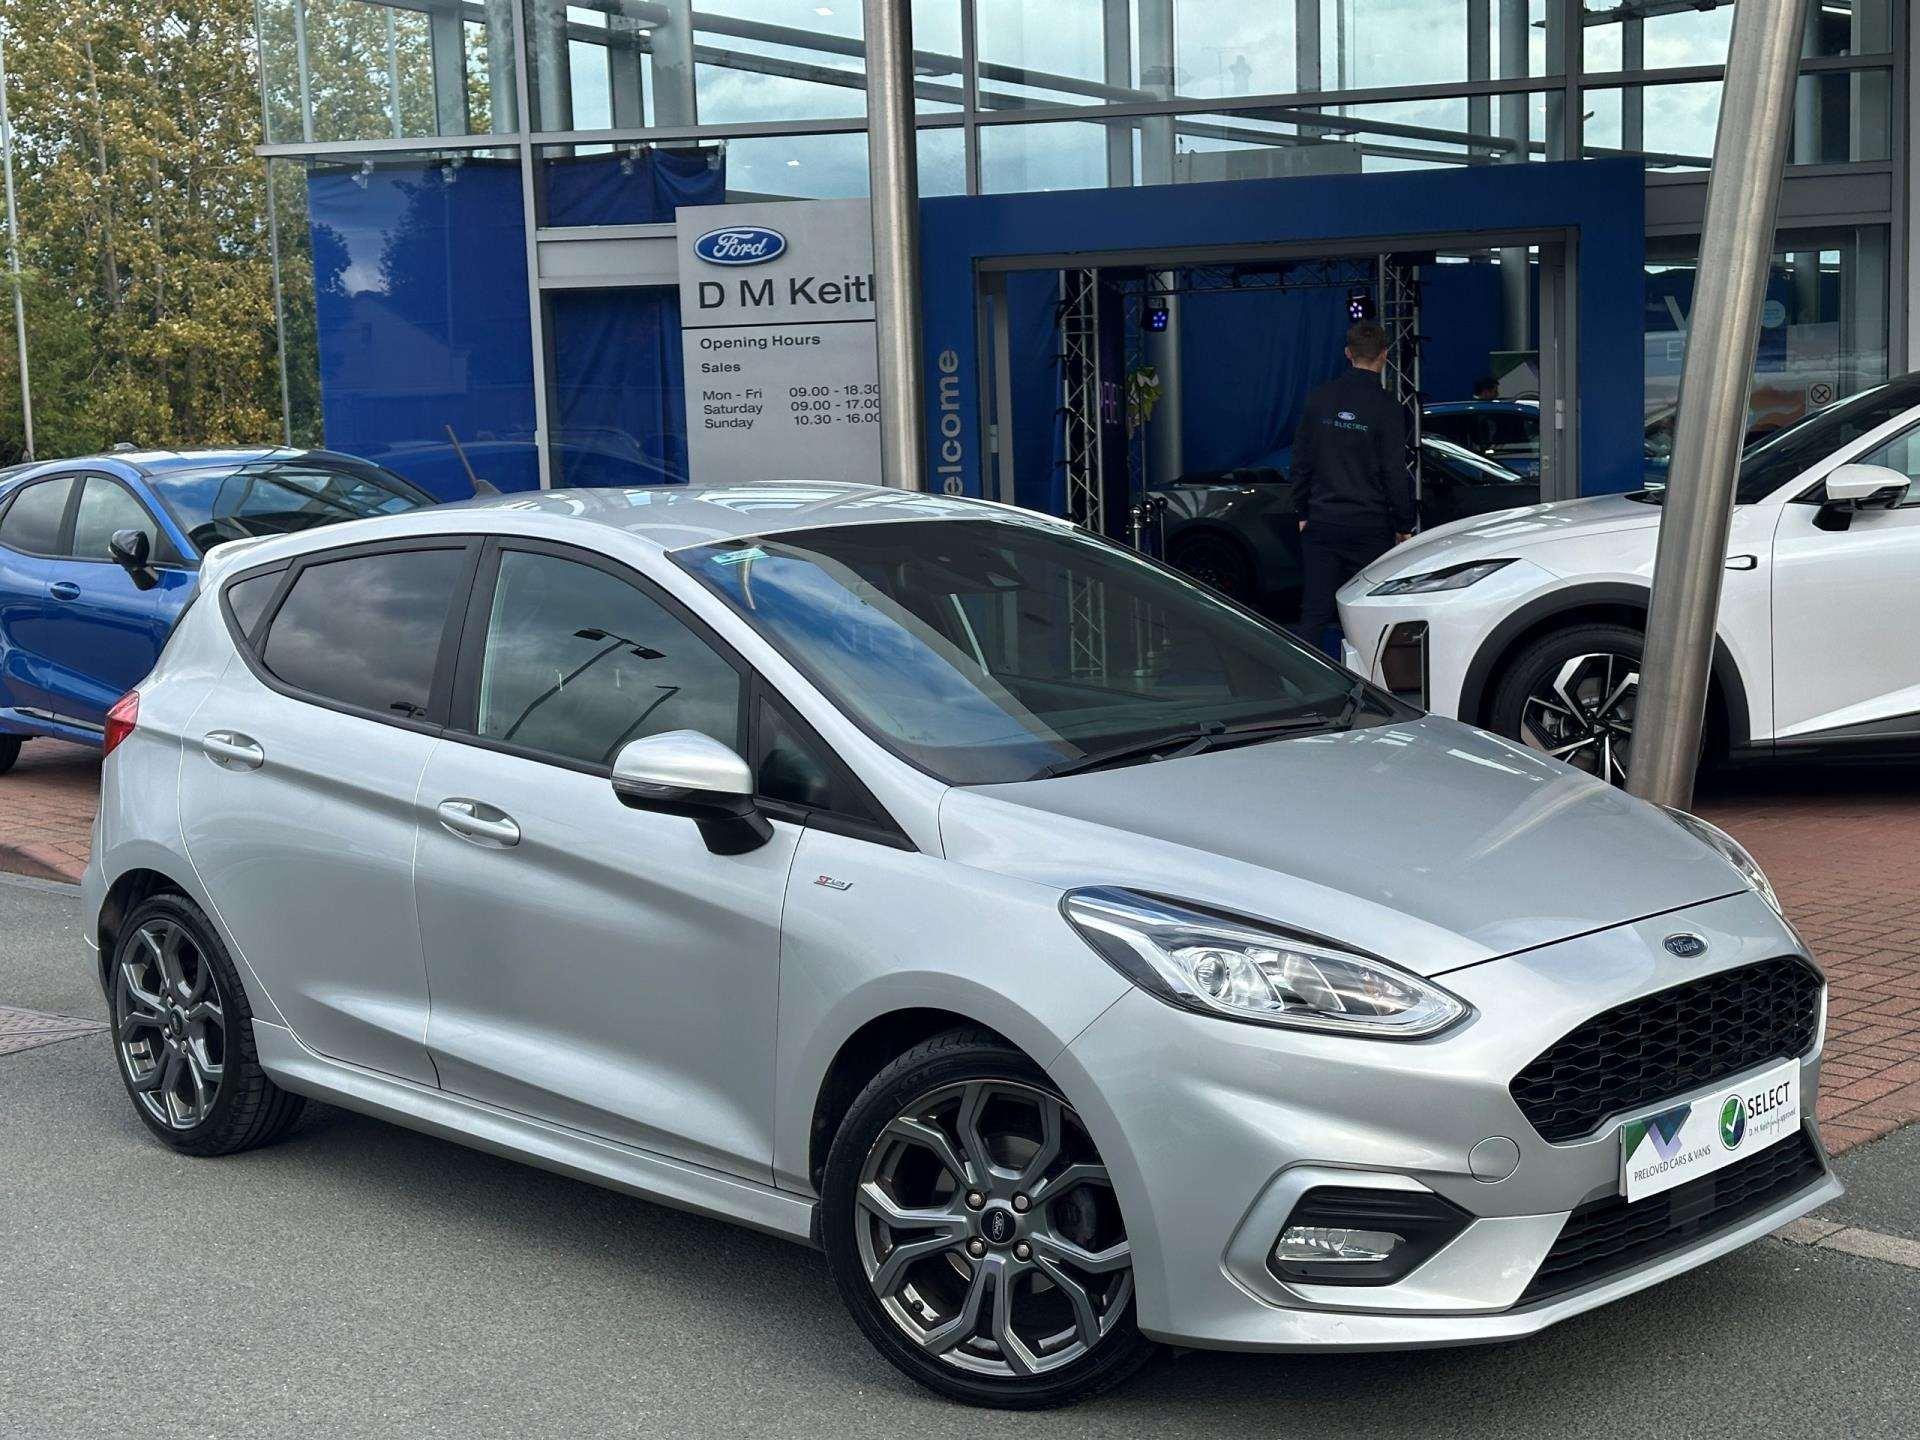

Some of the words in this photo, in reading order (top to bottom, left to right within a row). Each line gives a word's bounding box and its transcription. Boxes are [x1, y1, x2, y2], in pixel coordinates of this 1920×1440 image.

[713, 232, 768, 258] Ford
[699, 281, 725, 309] D
[740, 279, 774, 307] M
[700, 336, 767, 350] Opening
[772, 334, 821, 346] Hours
[701, 362, 741, 373] Sales
[703, 390, 731, 400] Mon
[745, 388, 762, 399] Fri
[789, 386, 829, 397] 09.00
[703, 403, 763, 415] Saturday
[790, 400, 831, 411] 09.00
[704, 417, 754, 430] Sunday
[794, 415, 831, 426] 10.30
[937, 350, 964, 496] elcome
[1747, 1081, 1790, 1119] SELECT
[1633, 1161, 1669, 1182] PRELOVED
[1670, 1154, 1687, 1169] CARS
[1687, 1152, 1694, 1162] &
[1693, 1144, 1711, 1160] VANS
